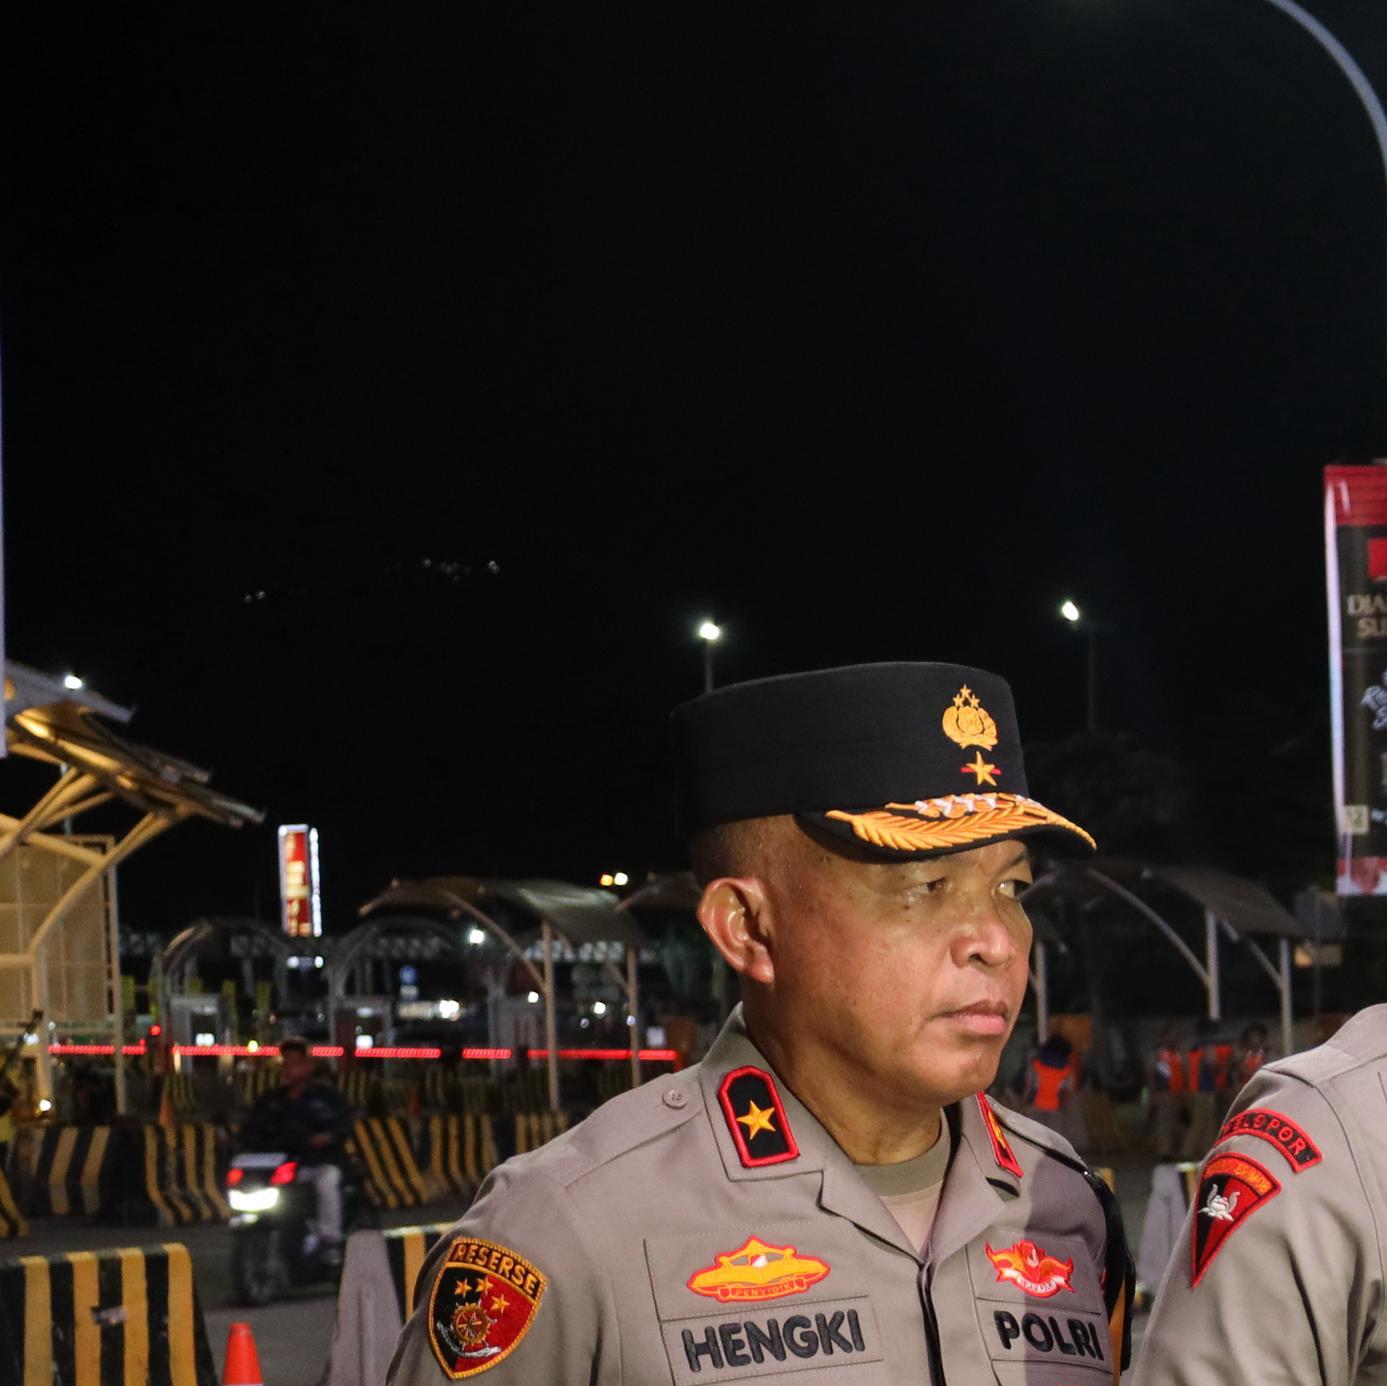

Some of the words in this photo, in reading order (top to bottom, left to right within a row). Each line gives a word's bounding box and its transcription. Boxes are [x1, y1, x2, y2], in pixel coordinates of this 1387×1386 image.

[454, 1244, 537, 1295] RESERSE
[735, 1283, 792, 1297] PENYIDIK
[681, 1309, 866, 1373] HENGKI
[993, 1310, 1105, 1361] POLRI
